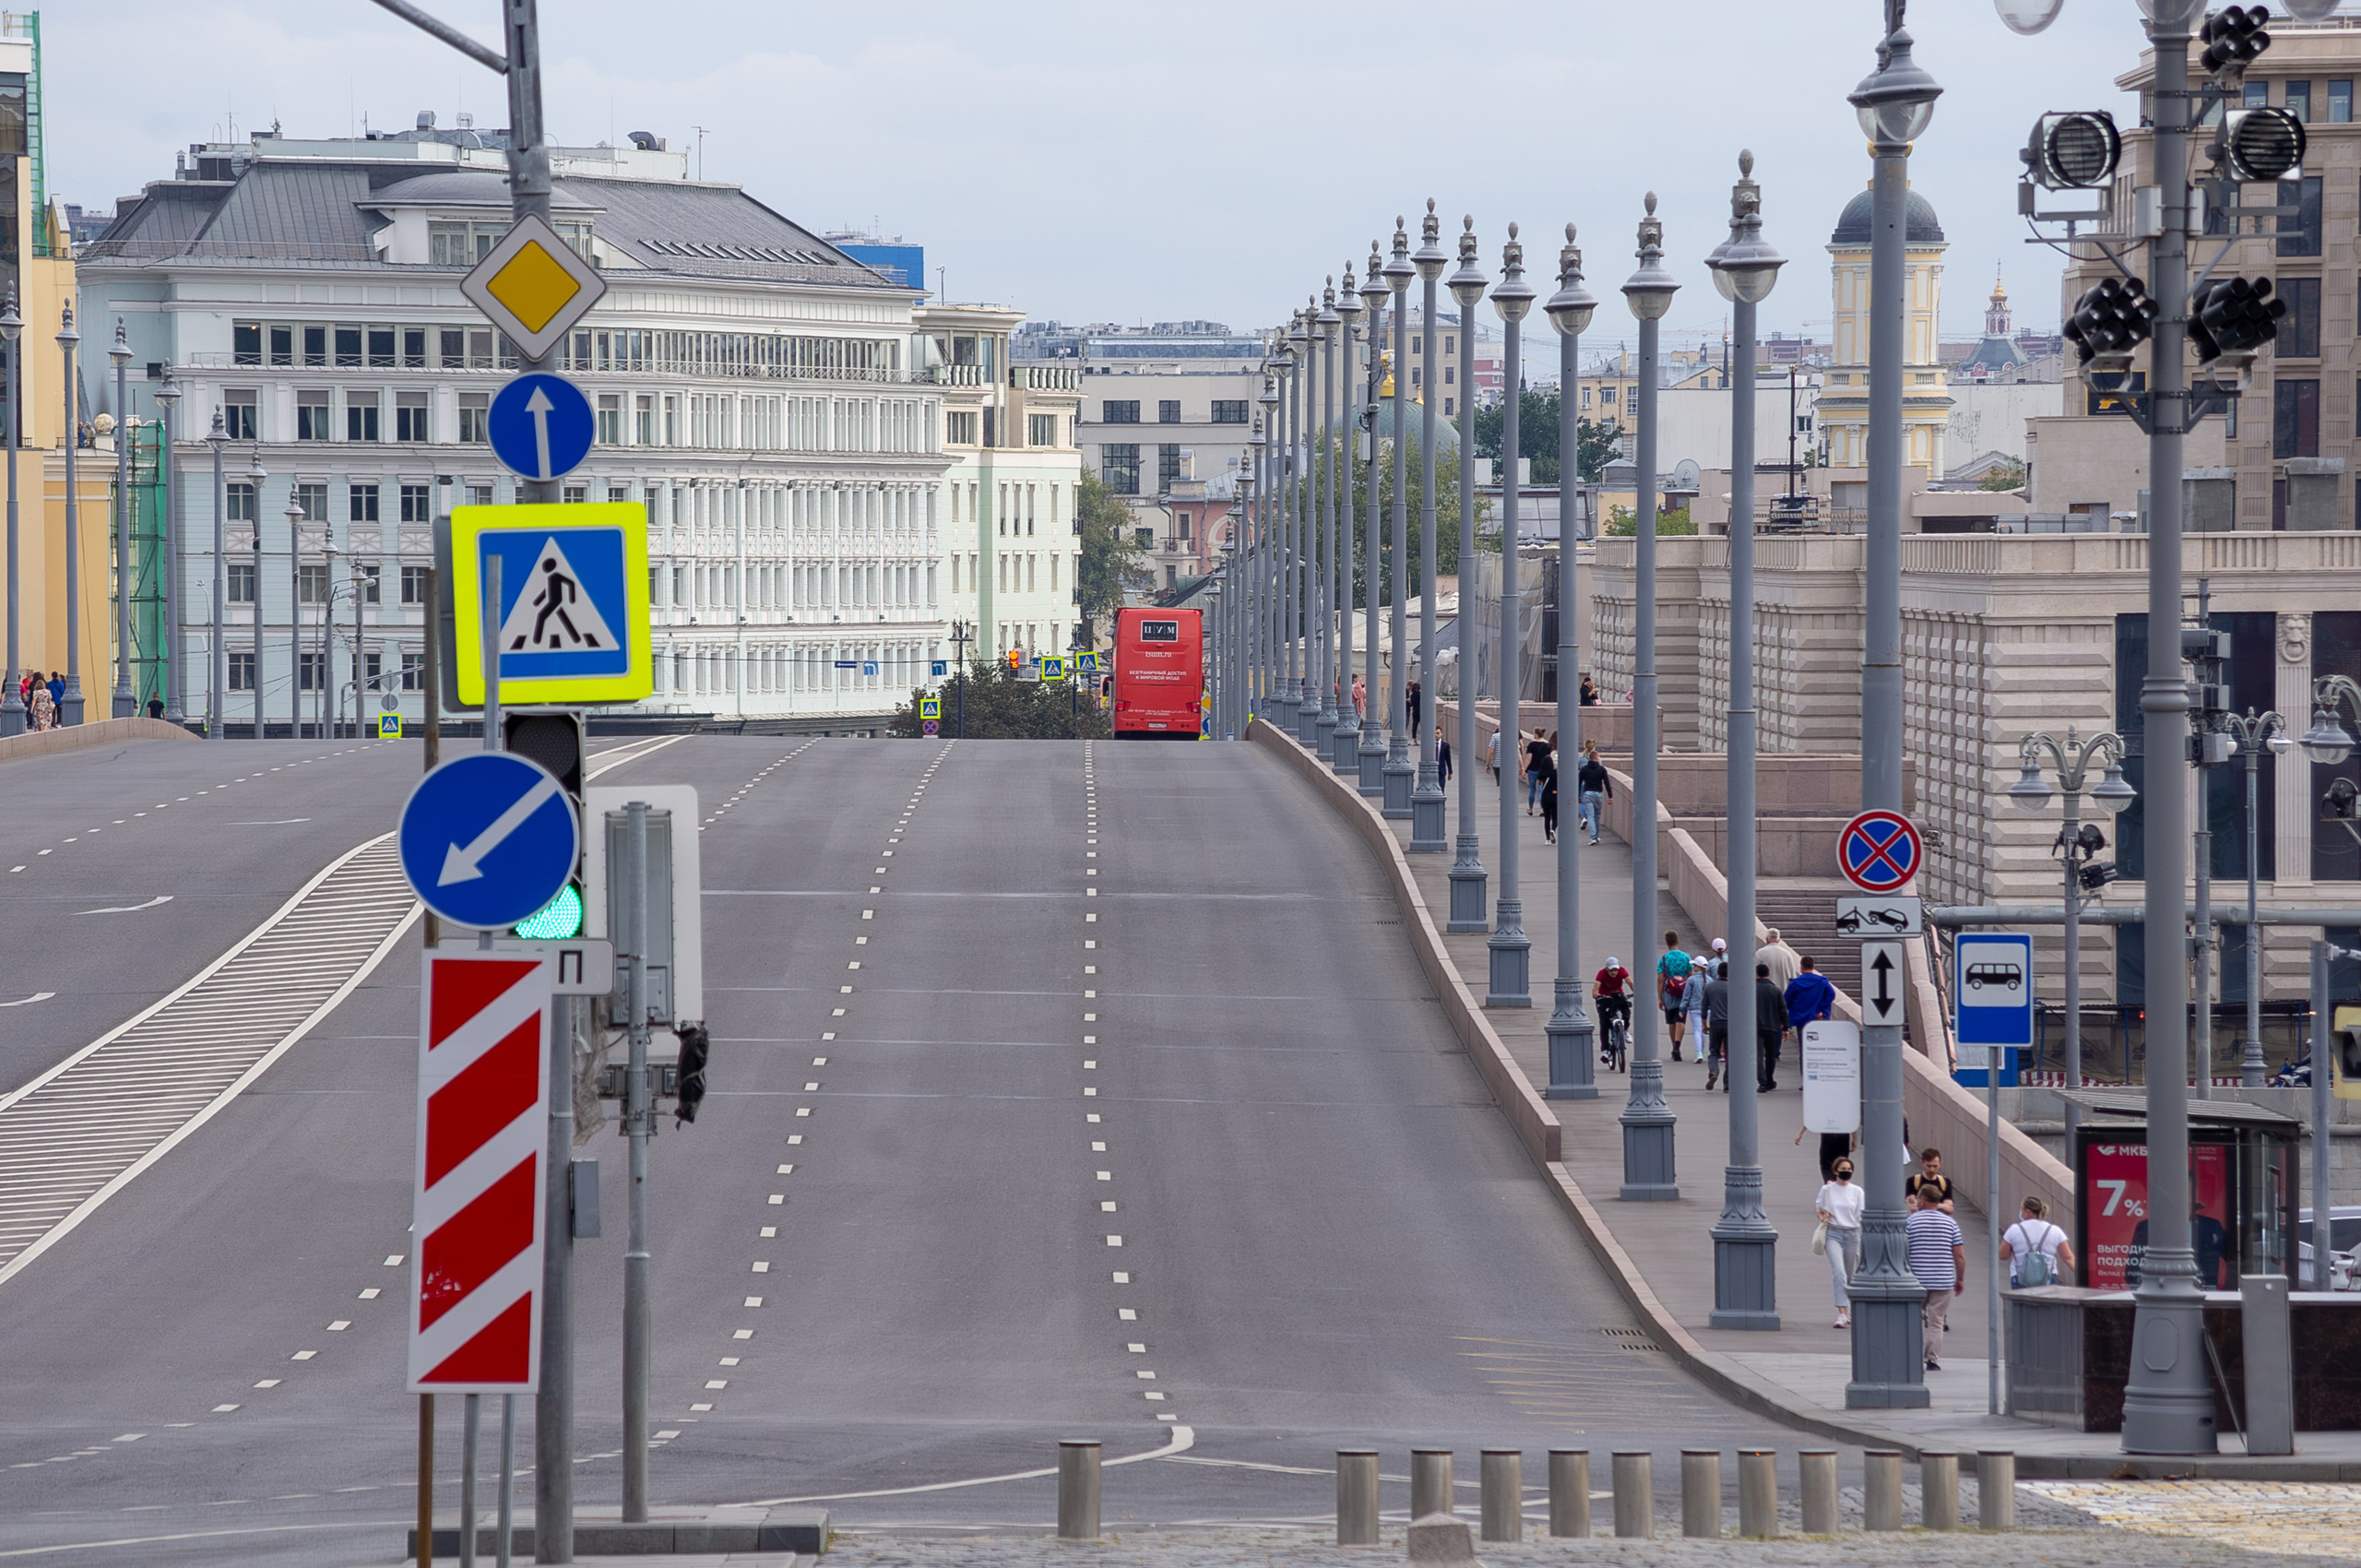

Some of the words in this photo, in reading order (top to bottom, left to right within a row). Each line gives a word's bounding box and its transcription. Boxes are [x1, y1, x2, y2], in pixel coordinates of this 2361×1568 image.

[2118, 1146, 2147, 1157] МКБ
[2096, 1244, 2146, 1255] ВЫГОДН
[2097, 1269, 2120, 1277] Вклад
